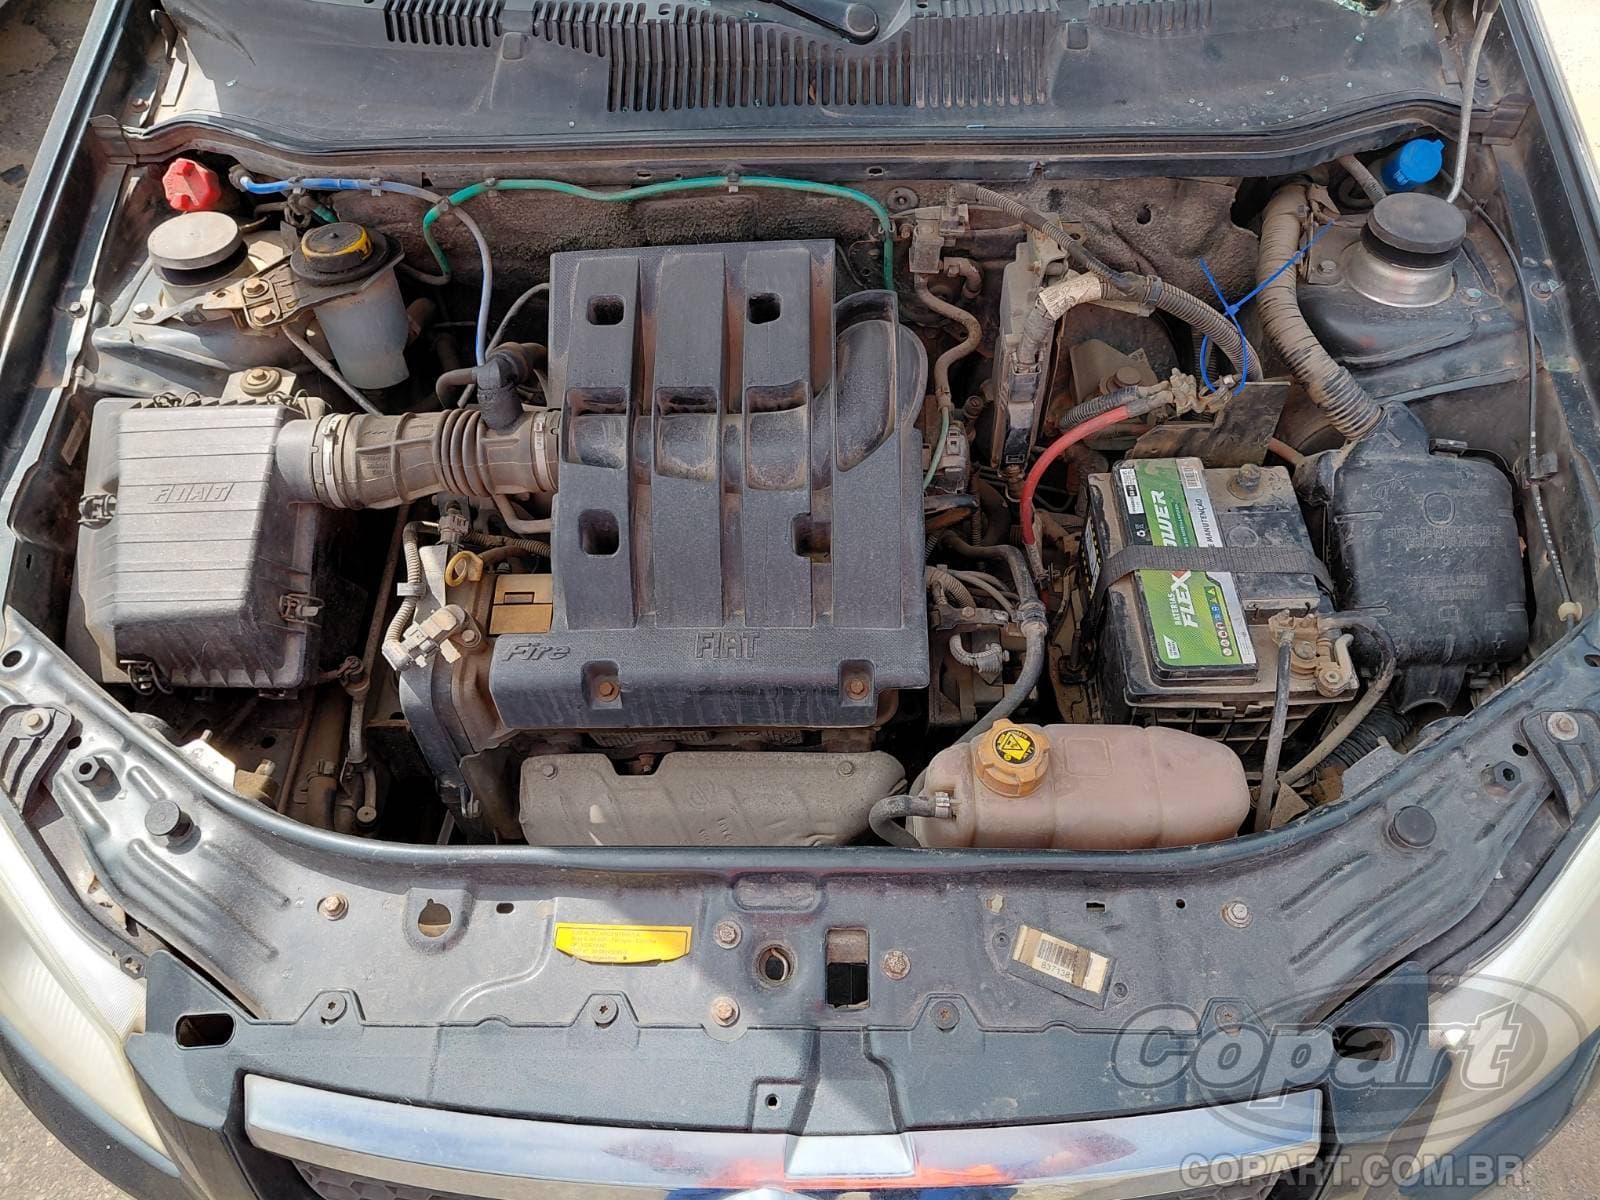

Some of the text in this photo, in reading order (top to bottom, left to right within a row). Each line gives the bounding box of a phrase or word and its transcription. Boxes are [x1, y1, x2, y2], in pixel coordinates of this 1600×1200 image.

[152, 485, 230, 502] FIAT
[1168, 593, 1182, 626] BATERIAS
[1170, 570, 1199, 628] FLEX
[501, 642, 571, 662] Fire
[695, 631, 760, 660] FIAT
